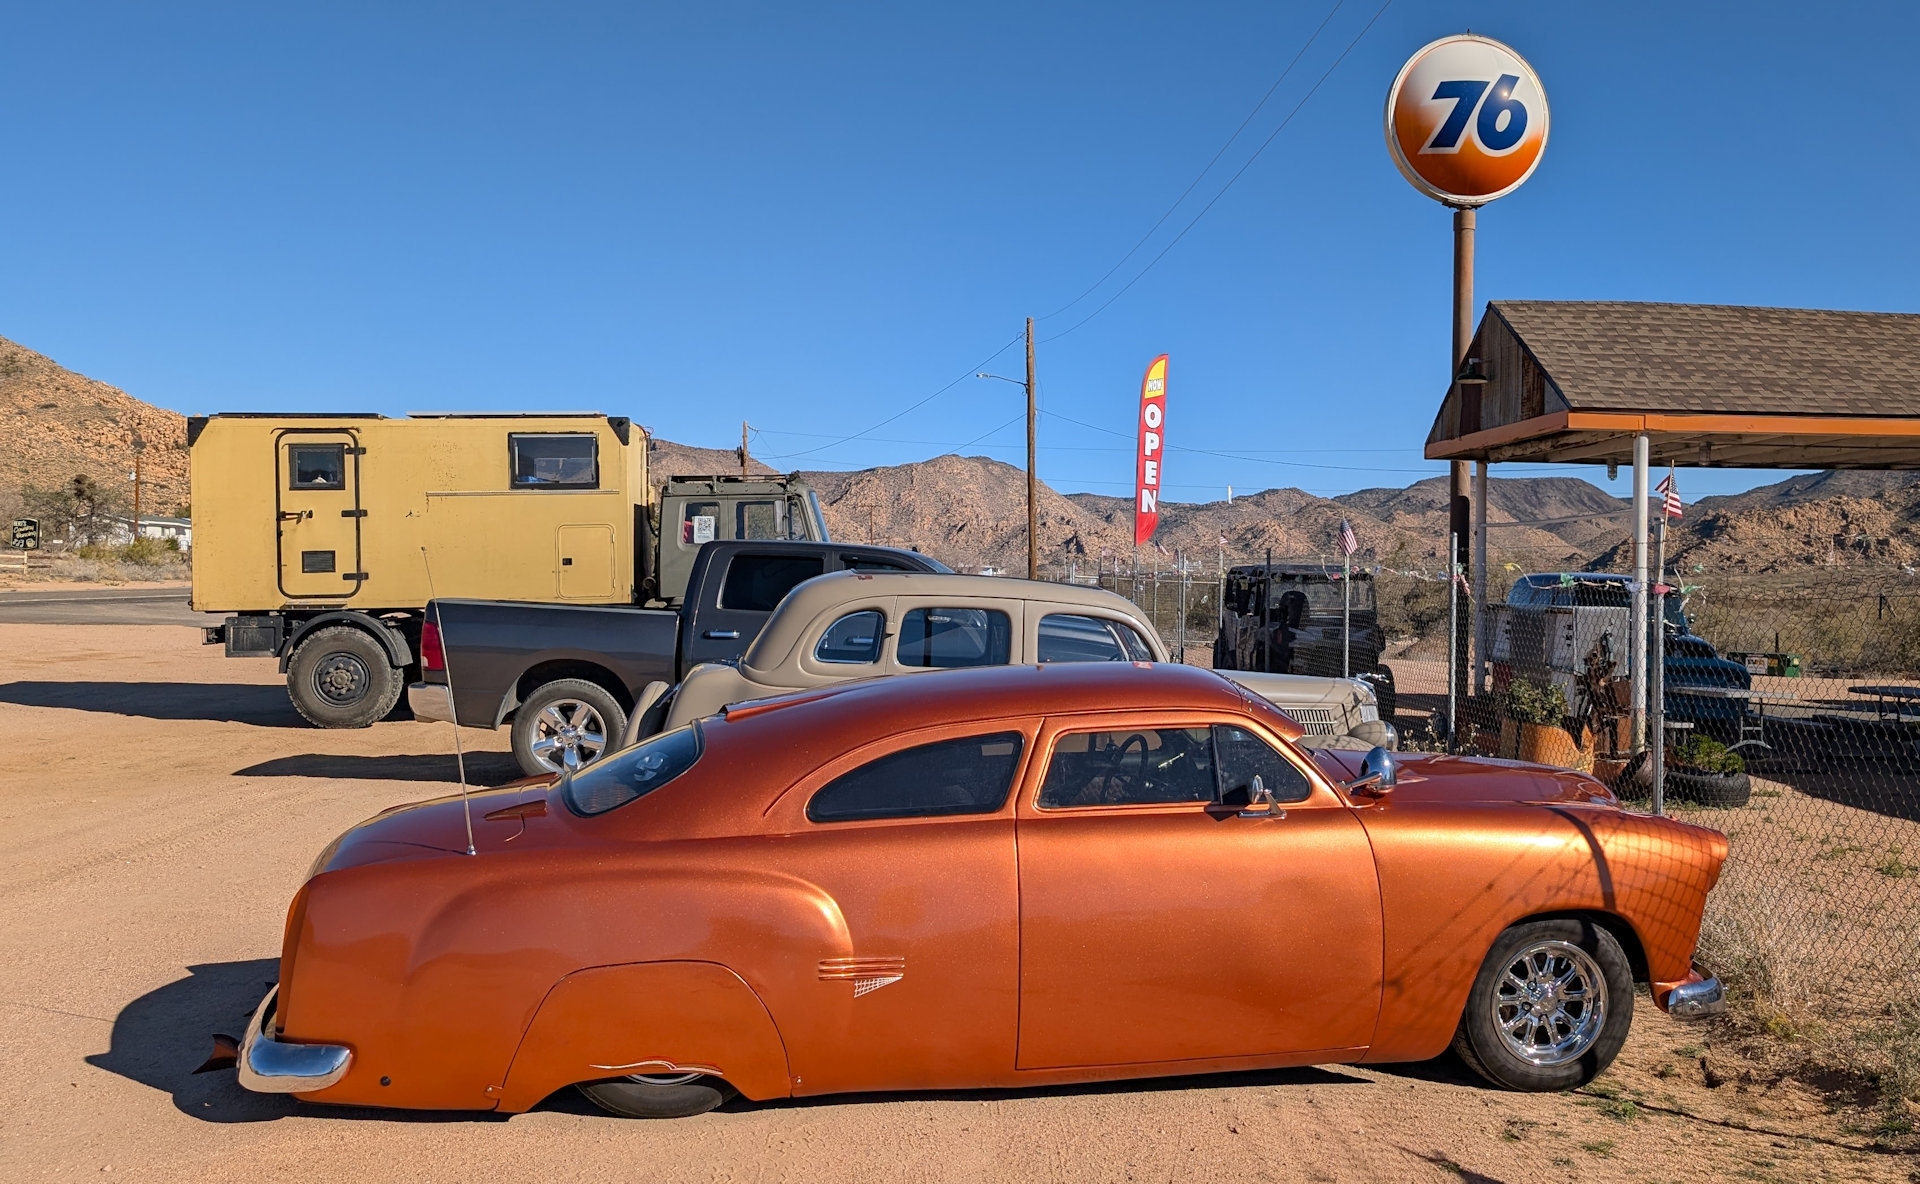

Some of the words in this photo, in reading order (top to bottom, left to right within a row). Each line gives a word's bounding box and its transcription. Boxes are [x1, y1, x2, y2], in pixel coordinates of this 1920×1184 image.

[1428, 74, 1528, 151] 76
[1147, 378, 1163, 392] NOW
[1141, 403, 1162, 513] OPEN
